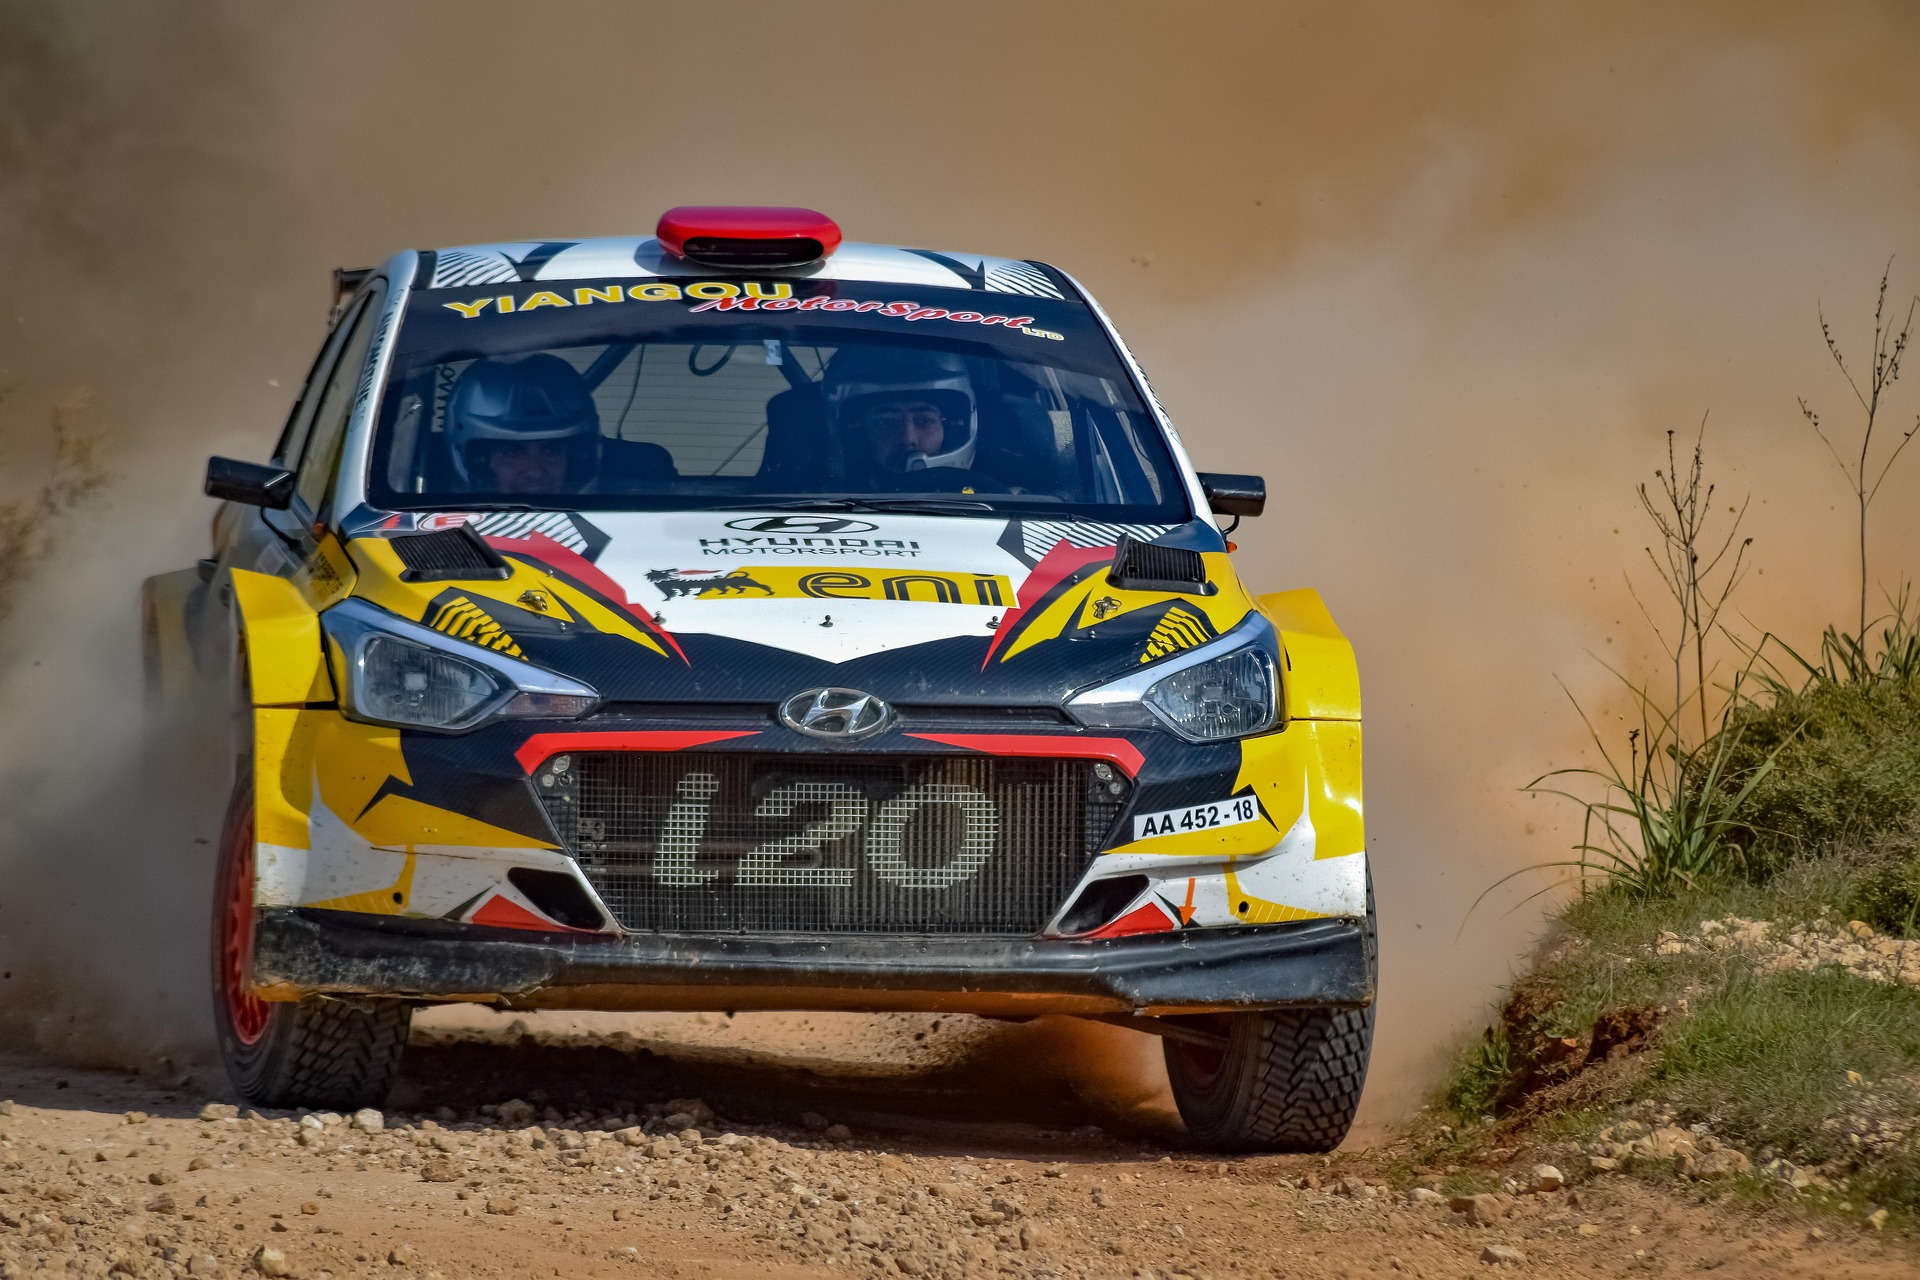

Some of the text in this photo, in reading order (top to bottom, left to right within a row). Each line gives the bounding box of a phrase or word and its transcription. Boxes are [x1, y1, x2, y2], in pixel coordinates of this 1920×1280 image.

[442, 282, 792, 319] YIANGOU
[1022, 327, 1064, 342] LTD
[699, 537, 920, 550] HYUNDAI
[703, 548, 921, 557] MOTORSPORT
[798, 572, 1003, 607] eni
[652, 773, 999, 888] i20
[1141, 816, 1176, 837] AA
